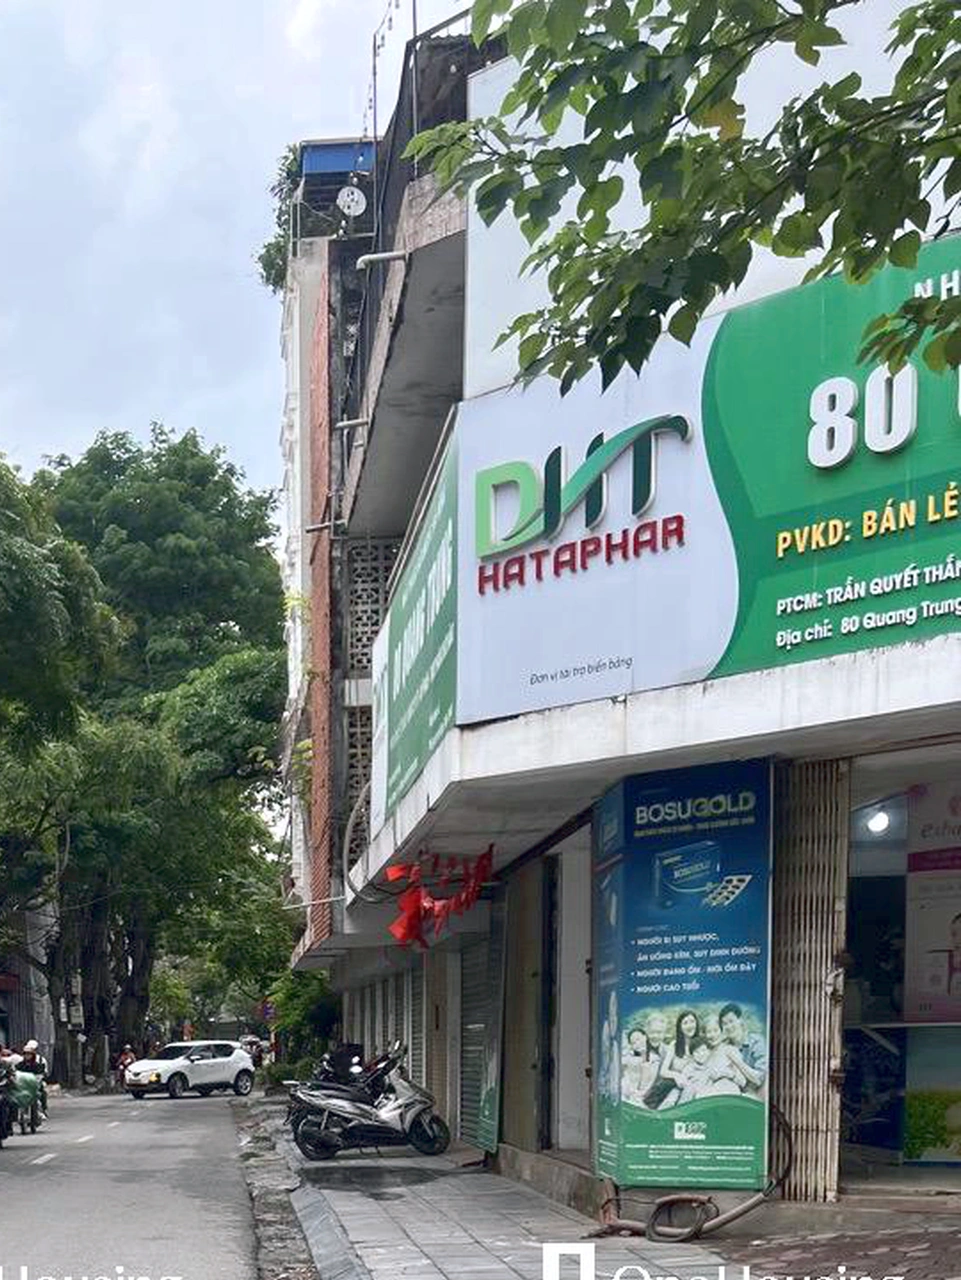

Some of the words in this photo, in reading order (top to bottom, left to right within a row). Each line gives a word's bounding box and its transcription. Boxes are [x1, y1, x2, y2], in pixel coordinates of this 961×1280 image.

[808, 361, 918, 468] 80
[777, 519, 852, 558] PVKD:
[862, 499, 917, 538] BÁN
[478, 514, 685, 595] HATAPHAR
[776, 591, 823, 616] PTCM:
[825, 576, 866, 605] TRẦN
[776, 629, 801, 650] Địa
[841, 617, 860, 634] 80
[863, 607, 917, 626] Quang
[635, 790, 757, 825] BOSUGOLD
